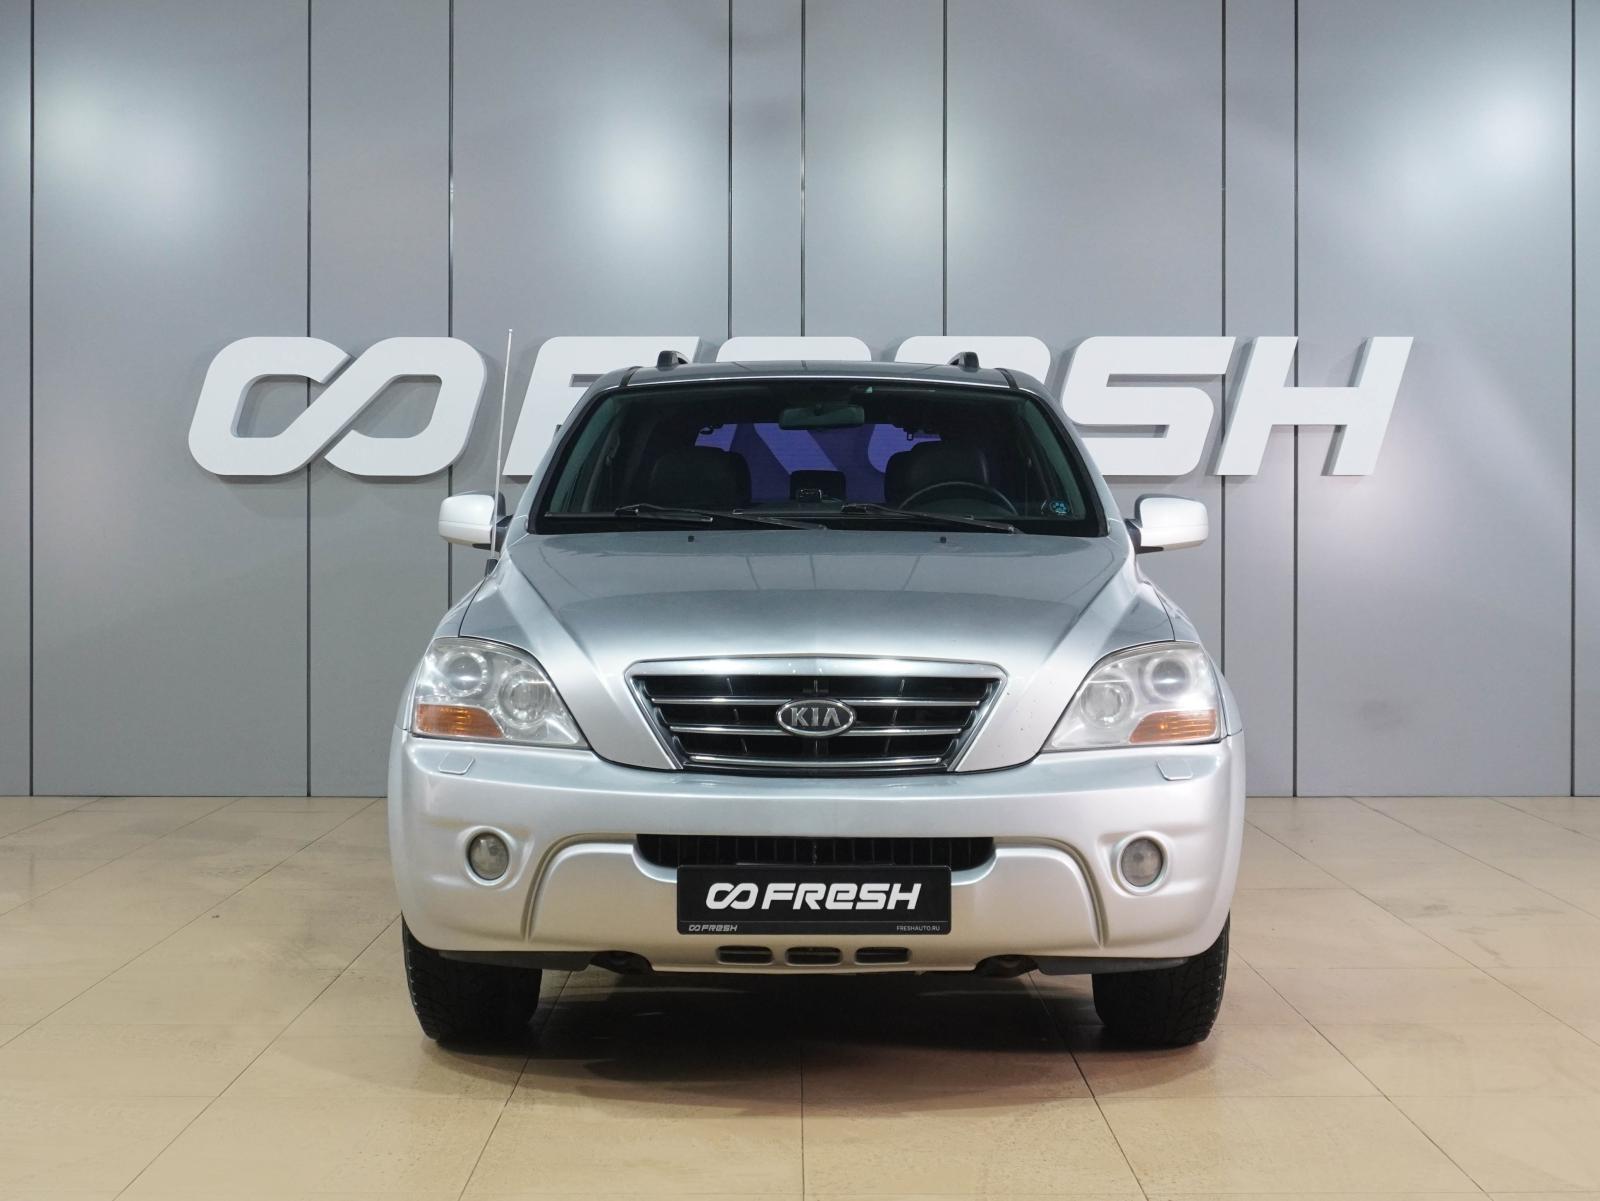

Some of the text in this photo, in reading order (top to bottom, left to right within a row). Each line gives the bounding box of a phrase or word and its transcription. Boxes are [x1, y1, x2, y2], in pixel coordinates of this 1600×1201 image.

[502, 336, 1414, 476] FSH
[790, 706, 841, 728] KIA
[760, 882, 923, 910] FRESH
